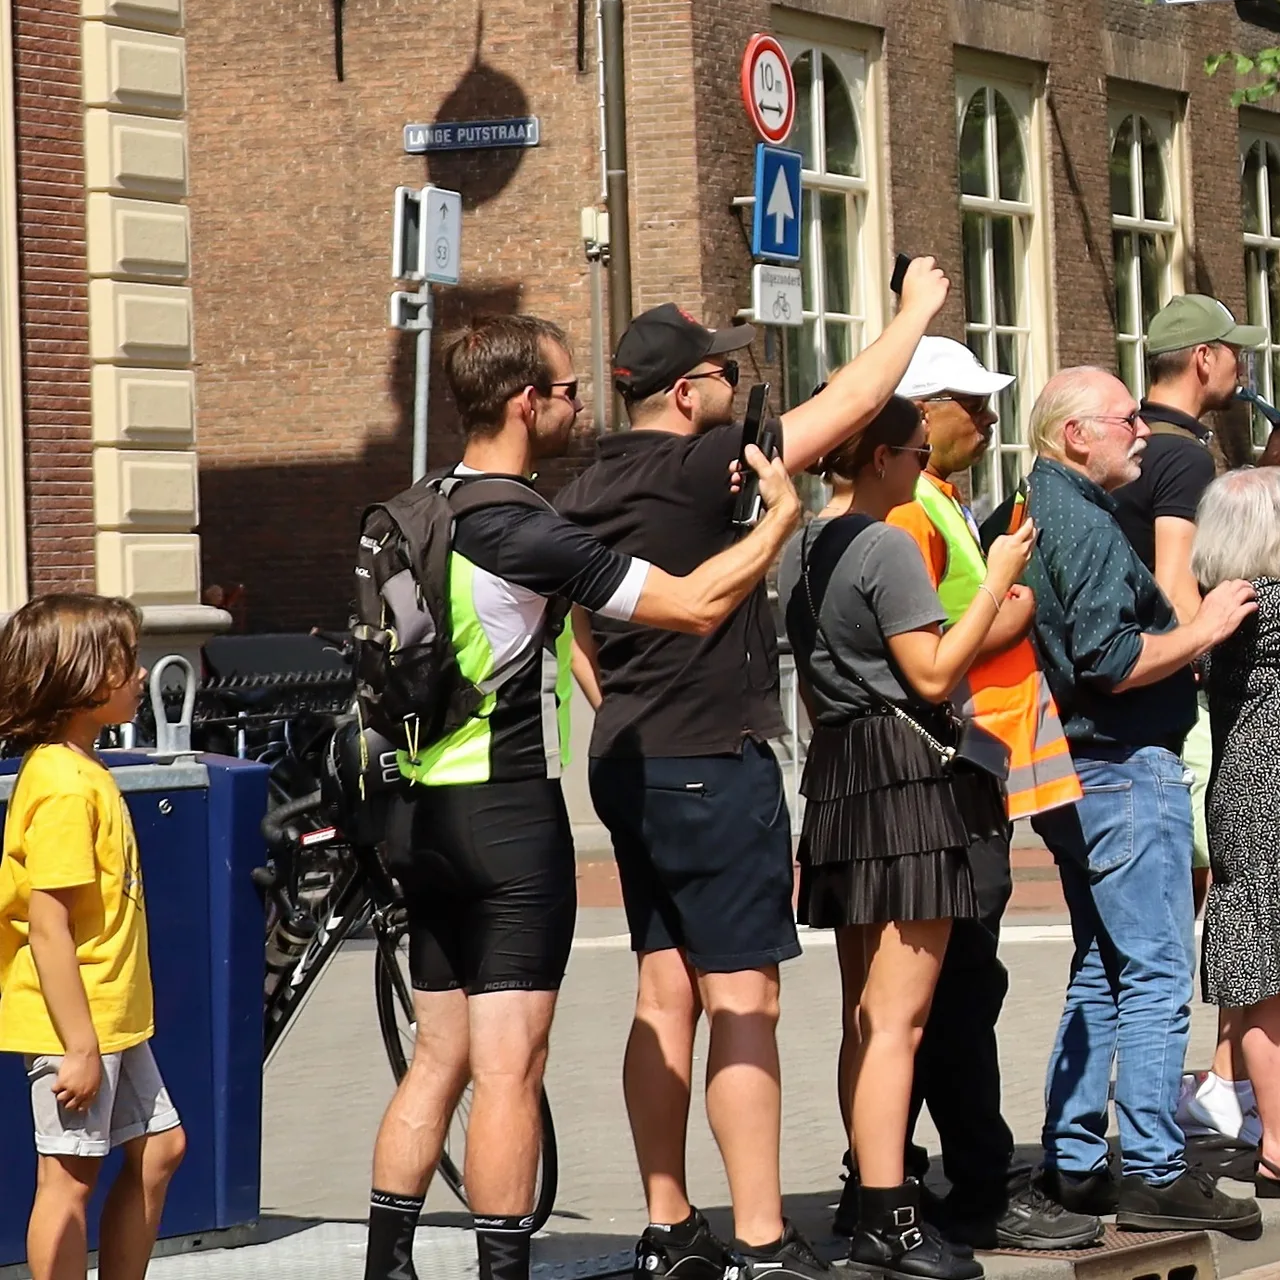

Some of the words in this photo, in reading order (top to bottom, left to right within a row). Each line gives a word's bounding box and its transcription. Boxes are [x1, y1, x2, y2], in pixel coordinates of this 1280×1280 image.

[409, 128, 452, 146] LANGE
[457, 123, 534, 142] PUTSTRAAT
[484, 980, 533, 991] ROGELLI
